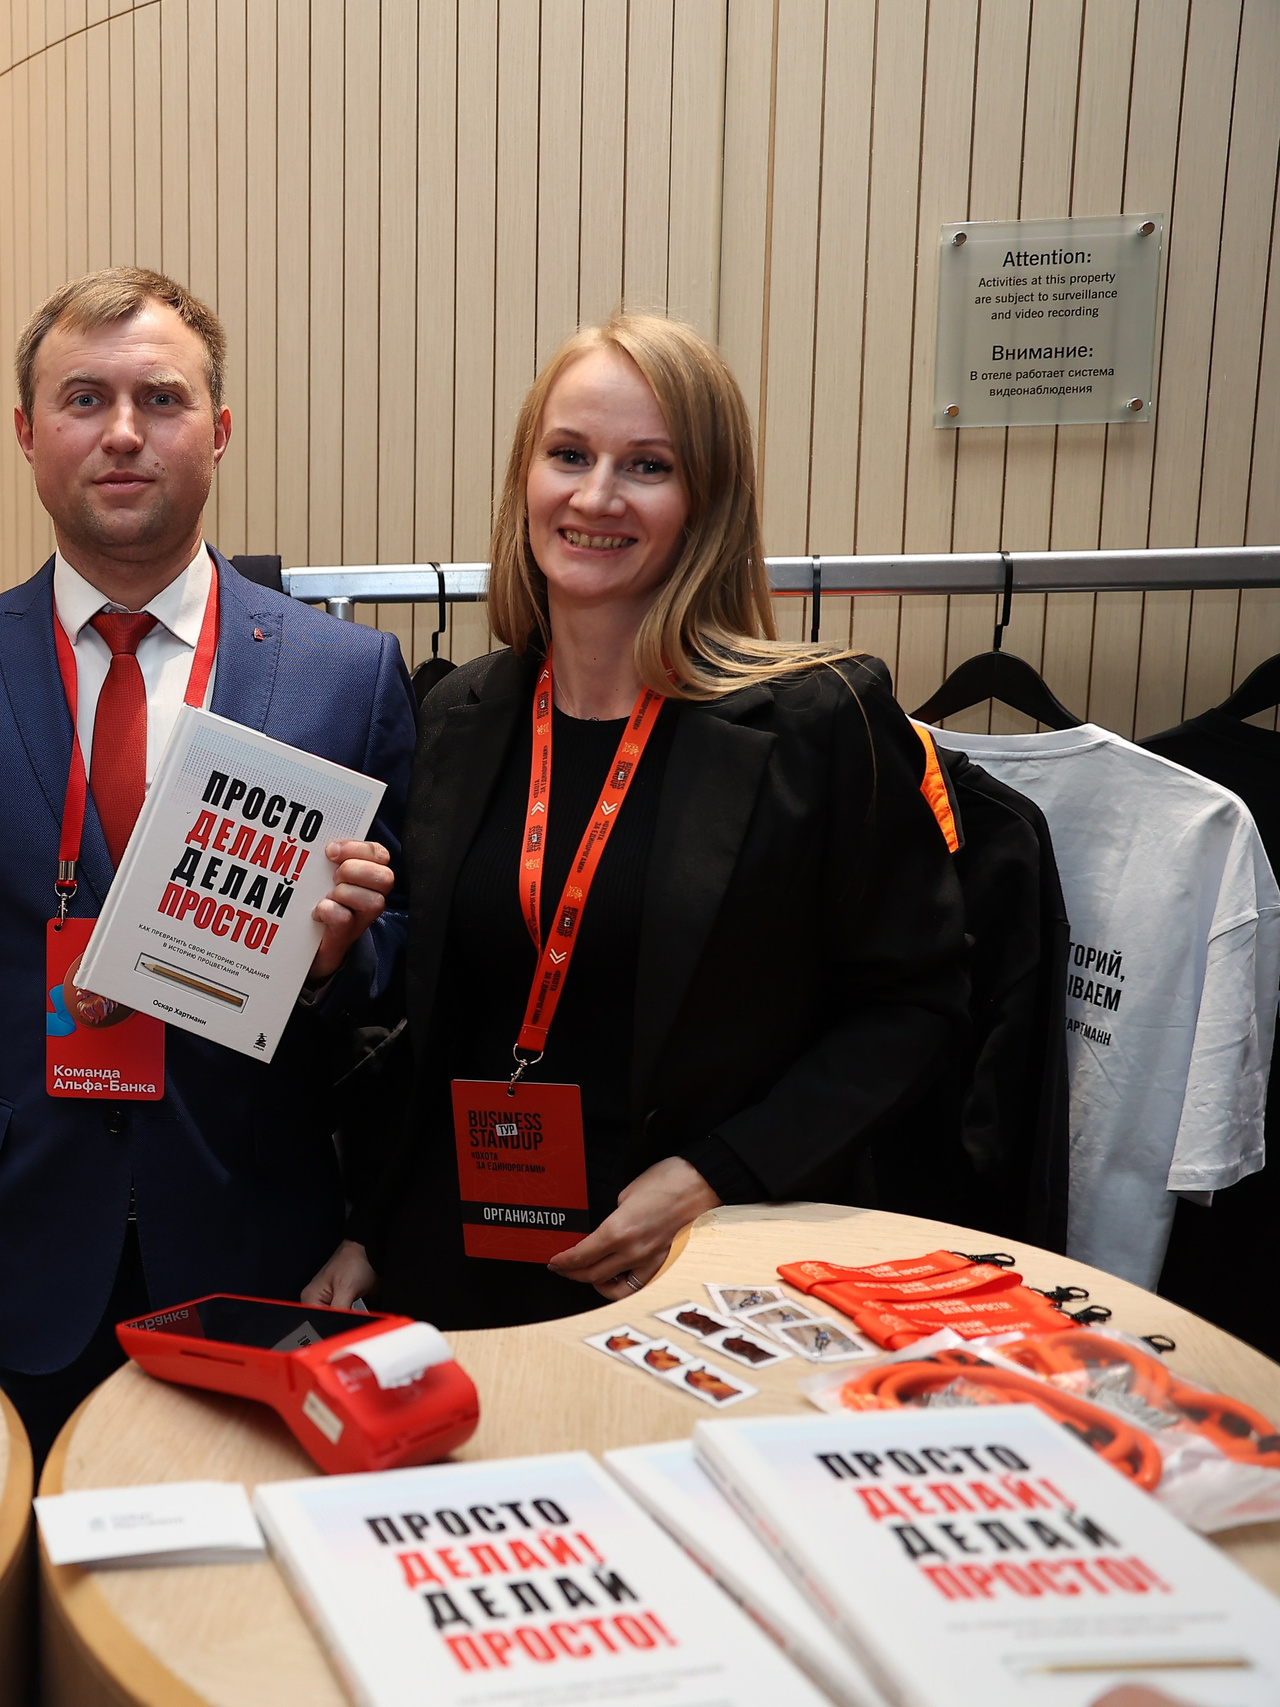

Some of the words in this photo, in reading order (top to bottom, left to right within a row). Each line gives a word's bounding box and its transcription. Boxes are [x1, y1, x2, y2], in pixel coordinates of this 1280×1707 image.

[1002, 249, 1092, 267] Attention:
[978, 276, 1028, 288] Activities
[1031, 276, 1043, 286] at
[1045, 274, 1066, 285] this
[1069, 272, 1116, 284] property
[974, 295, 992, 305] are
[995, 292, 1035, 305] subject
[1038, 292, 1049, 302] to
[1052, 289, 1118, 301] surveillance
[991, 310, 1012, 320] and
[1015, 308, 1044, 319] video
[1047, 306, 1099, 318] recording
[991, 345, 1094, 361] Внимание:
[970, 371, 978, 381] В
[981, 371, 1012, 381] отеле
[1015, 368, 1065, 382] работает
[1068, 367, 1115, 378] система
[989, 385, 1093, 397] видеонаблюдения
[201, 769, 324, 843] ПРОСТО
[184, 809, 309, 882] ДЕЛАЙ!
[170, 847, 295, 918] ДЕЛАЙ
[157, 882, 280, 954] ПРОСТО!
[138, 923, 150, 933] КАК
[151, 927, 187, 948] ПРЕВРАТИТЬ
[188, 942, 205, 955] СВОЮ
[206, 949, 235, 966] ИСТОРИЮ
[235, 960, 270, 980] СТРАДАНИЯ
[168, 944, 196, 961] ИСТОРИЮ
[197, 955, 239, 977] ПРОЦВЕТАНИЯ
[1069, 941, 1125, 982] ТОРИЙ,
[152, 999, 174, 1014] Оскар
[174, 1007, 207, 1026] Хартманн
[1065, 1017, 1112, 1046] АРТМАНН
[53, 1064, 121, 1080] Команда
[53, 1078, 156, 1094] Альфа-Банка
[468, 1110, 543, 1131] BUSINESS
[499, 1124, 515, 1135] ТУР
[469, 1129, 543, 1150] STANDUP
[471, 1152, 498, 1161] «ОХОТА
[476, 1162, 486, 1170] ЗА
[487, 1163, 545, 1173] ЕДИНОРОГАМИ»
[483, 1207, 566, 1226] ОРГАНИЗАТОР
[816, 1443, 1031, 1480] ПРОСТО
[853, 1473, 1078, 1523] ДЕЛАЙ!
[365, 1497, 571, 1546] ПРОСТО
[888, 1509, 1121, 1561] ДЕЛАЙ
[396, 1529, 607, 1590] ДЕЛАЙ!
[920, 1556, 1173, 1602] ПРОСТО!
[423, 1561, 640, 1633] ДЕЛАЙ
[442, 1610, 680, 1675] ПРОСТО!
